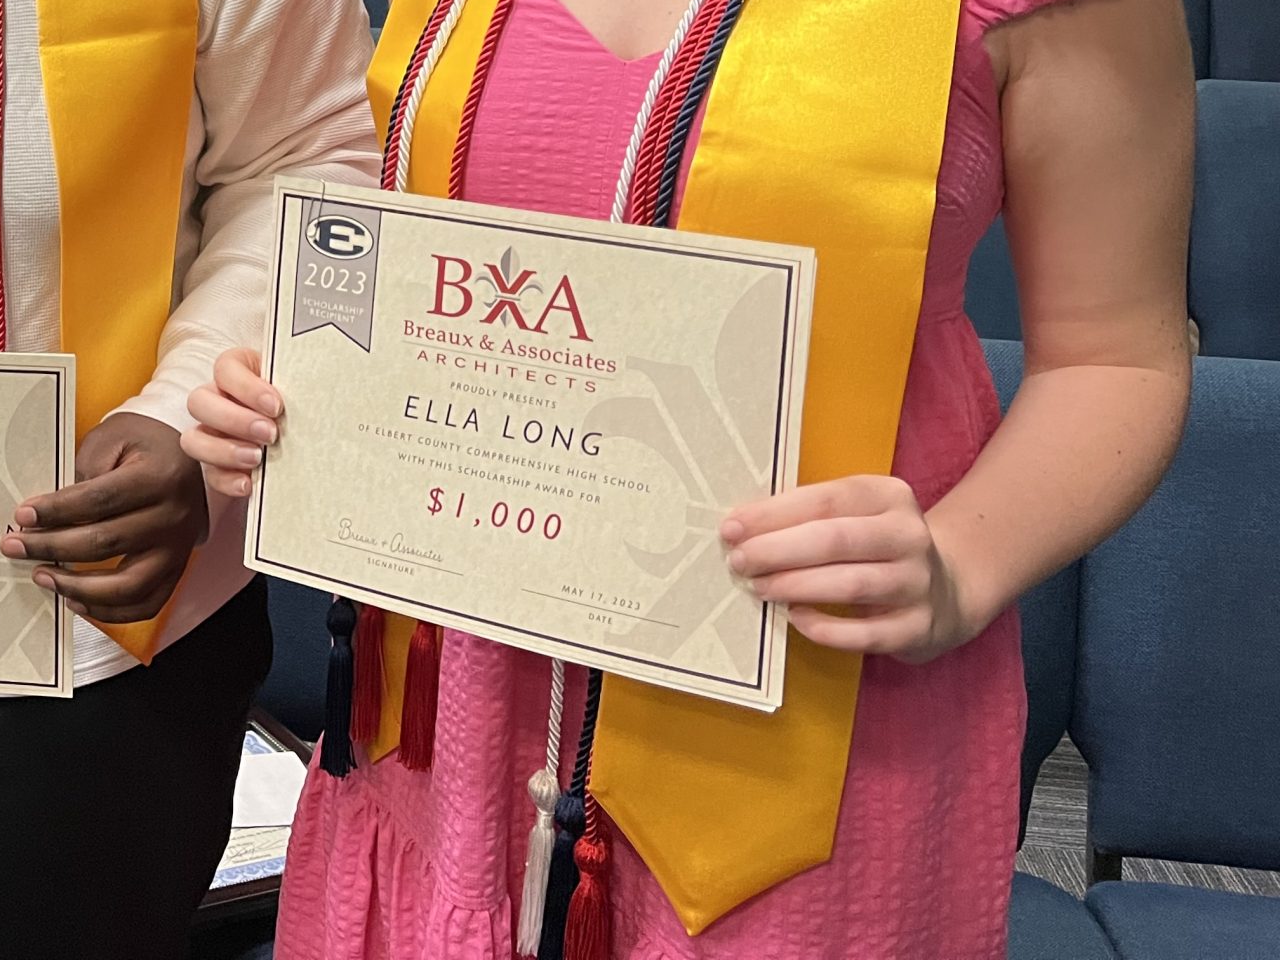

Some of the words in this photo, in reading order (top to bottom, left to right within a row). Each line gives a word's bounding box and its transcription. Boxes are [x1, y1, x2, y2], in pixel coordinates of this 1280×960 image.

[304, 263, 367, 295] 2023
[303, 297, 365, 316] SCHOLARSHIP
[309, 308, 355, 323] RECIPIENT
[403, 319, 473, 348] Breaux
[479, 334, 494, 351] &
[500, 339, 617, 373] Associates
[417, 350, 597, 393] ARCHITECTS
[450, 382, 497, 397] PROUDLY
[502, 391, 557, 409] PRESENTS
[404, 395, 479, 432] ELLA
[502, 415, 603, 456] LONG
[358, 423, 370, 432] OF
[375, 427, 413, 441] ELBERT
[417, 436, 461, 452] COUNTY
[466, 446, 561, 474] COMPREHENSIVE
[567, 468, 597, 481] HIGH
[603, 475, 651, 493] SCHOOL
[398, 452, 425, 465] WITH
[429, 459, 452, 471] THIS
[457, 465, 531, 488] SCHOLARSHIP
[535, 483, 574, 498] AWARD
[580, 492, 601, 504] FOR
[427, 487, 562, 540] $1,000
[390, 532, 443, 562] Associates
[367, 557, 415, 576] SIGNATURE
[561, 585, 584, 597] MAY
[612, 596, 641, 610] 2023
[588, 612, 613, 625] DATE
